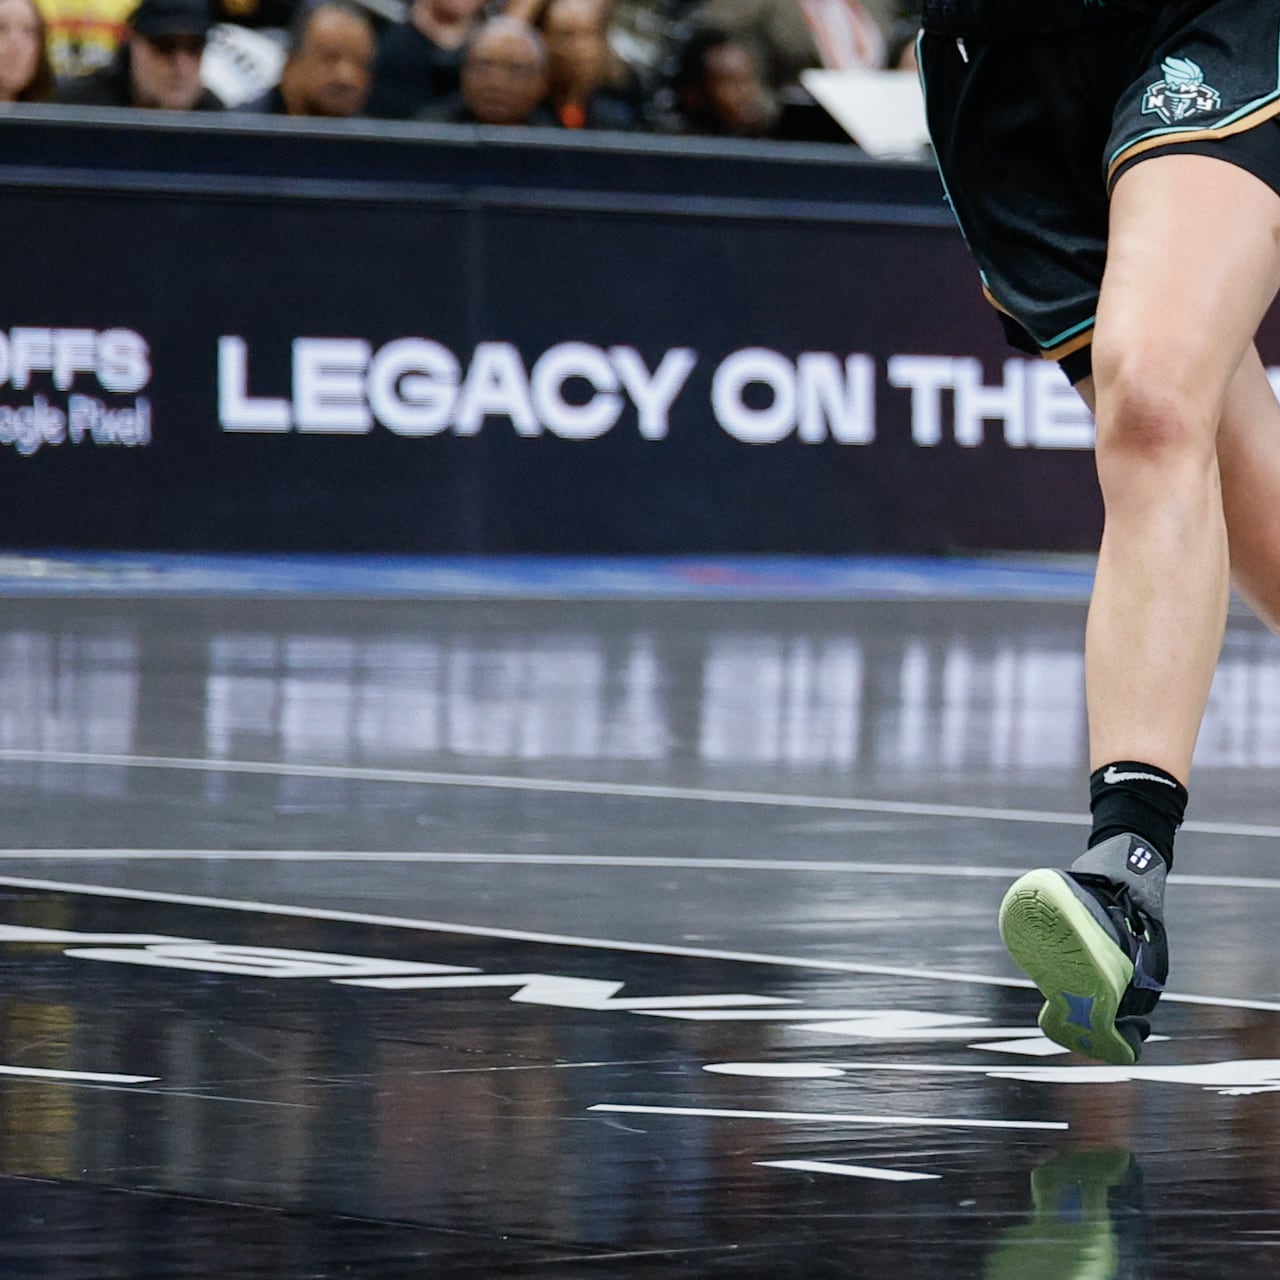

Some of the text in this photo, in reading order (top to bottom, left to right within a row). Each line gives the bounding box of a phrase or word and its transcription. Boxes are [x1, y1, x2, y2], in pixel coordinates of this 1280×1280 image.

[0, 326, 152, 393] FFS
[217, 333, 1098, 450] LEGACY ON THE
